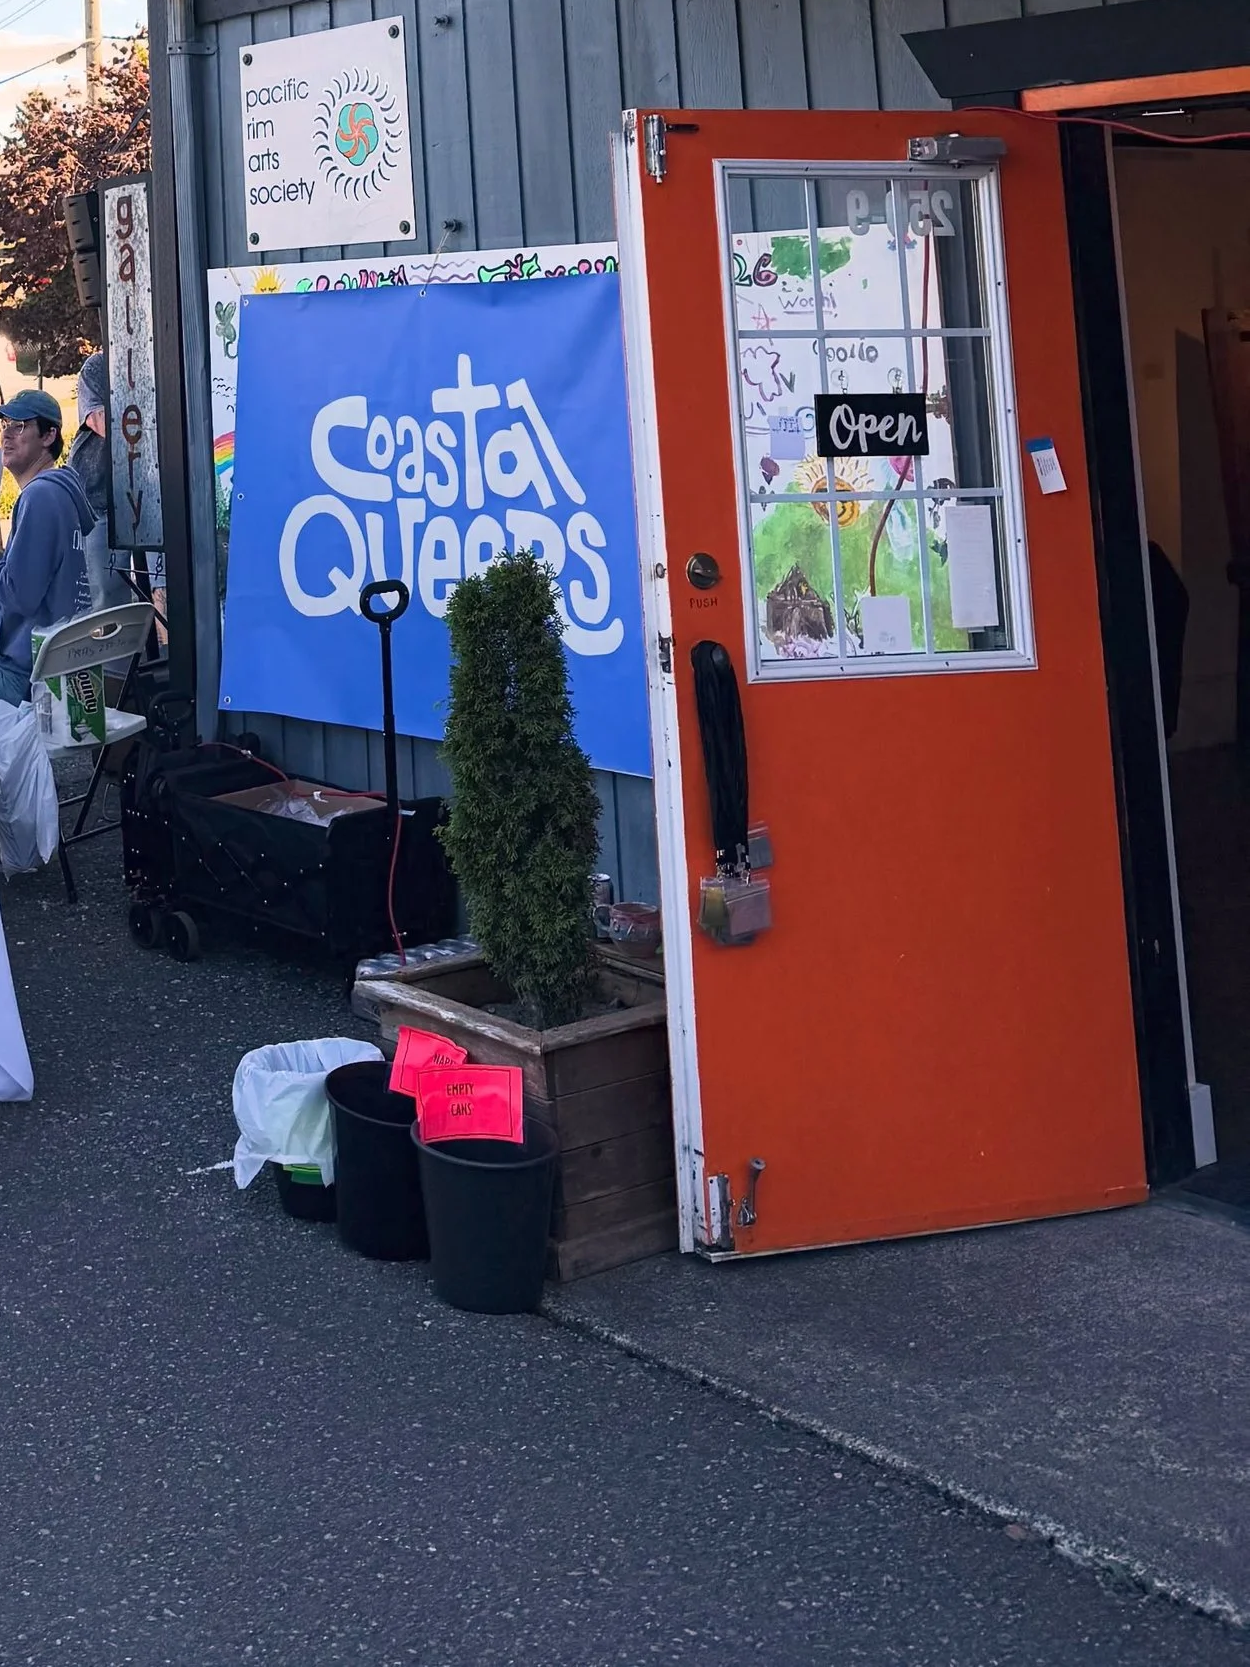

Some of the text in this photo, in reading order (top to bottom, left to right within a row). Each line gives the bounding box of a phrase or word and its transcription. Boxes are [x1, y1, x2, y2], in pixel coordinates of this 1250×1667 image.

[245, 78, 309, 113] pacific
[247, 117, 274, 140] rim
[248, 148, 280, 173] arts
[250, 177, 315, 206] society
[116, 195, 144, 530] gallery
[311, 353, 586, 510] Coastal
[829, 403, 923, 453] Open
[689, 596, 718, 609] PUSH
[77, 668, 98, 714] ounty
[446, 1083, 474, 1095] EMPTY
[450, 1103, 472, 1116] CANS
